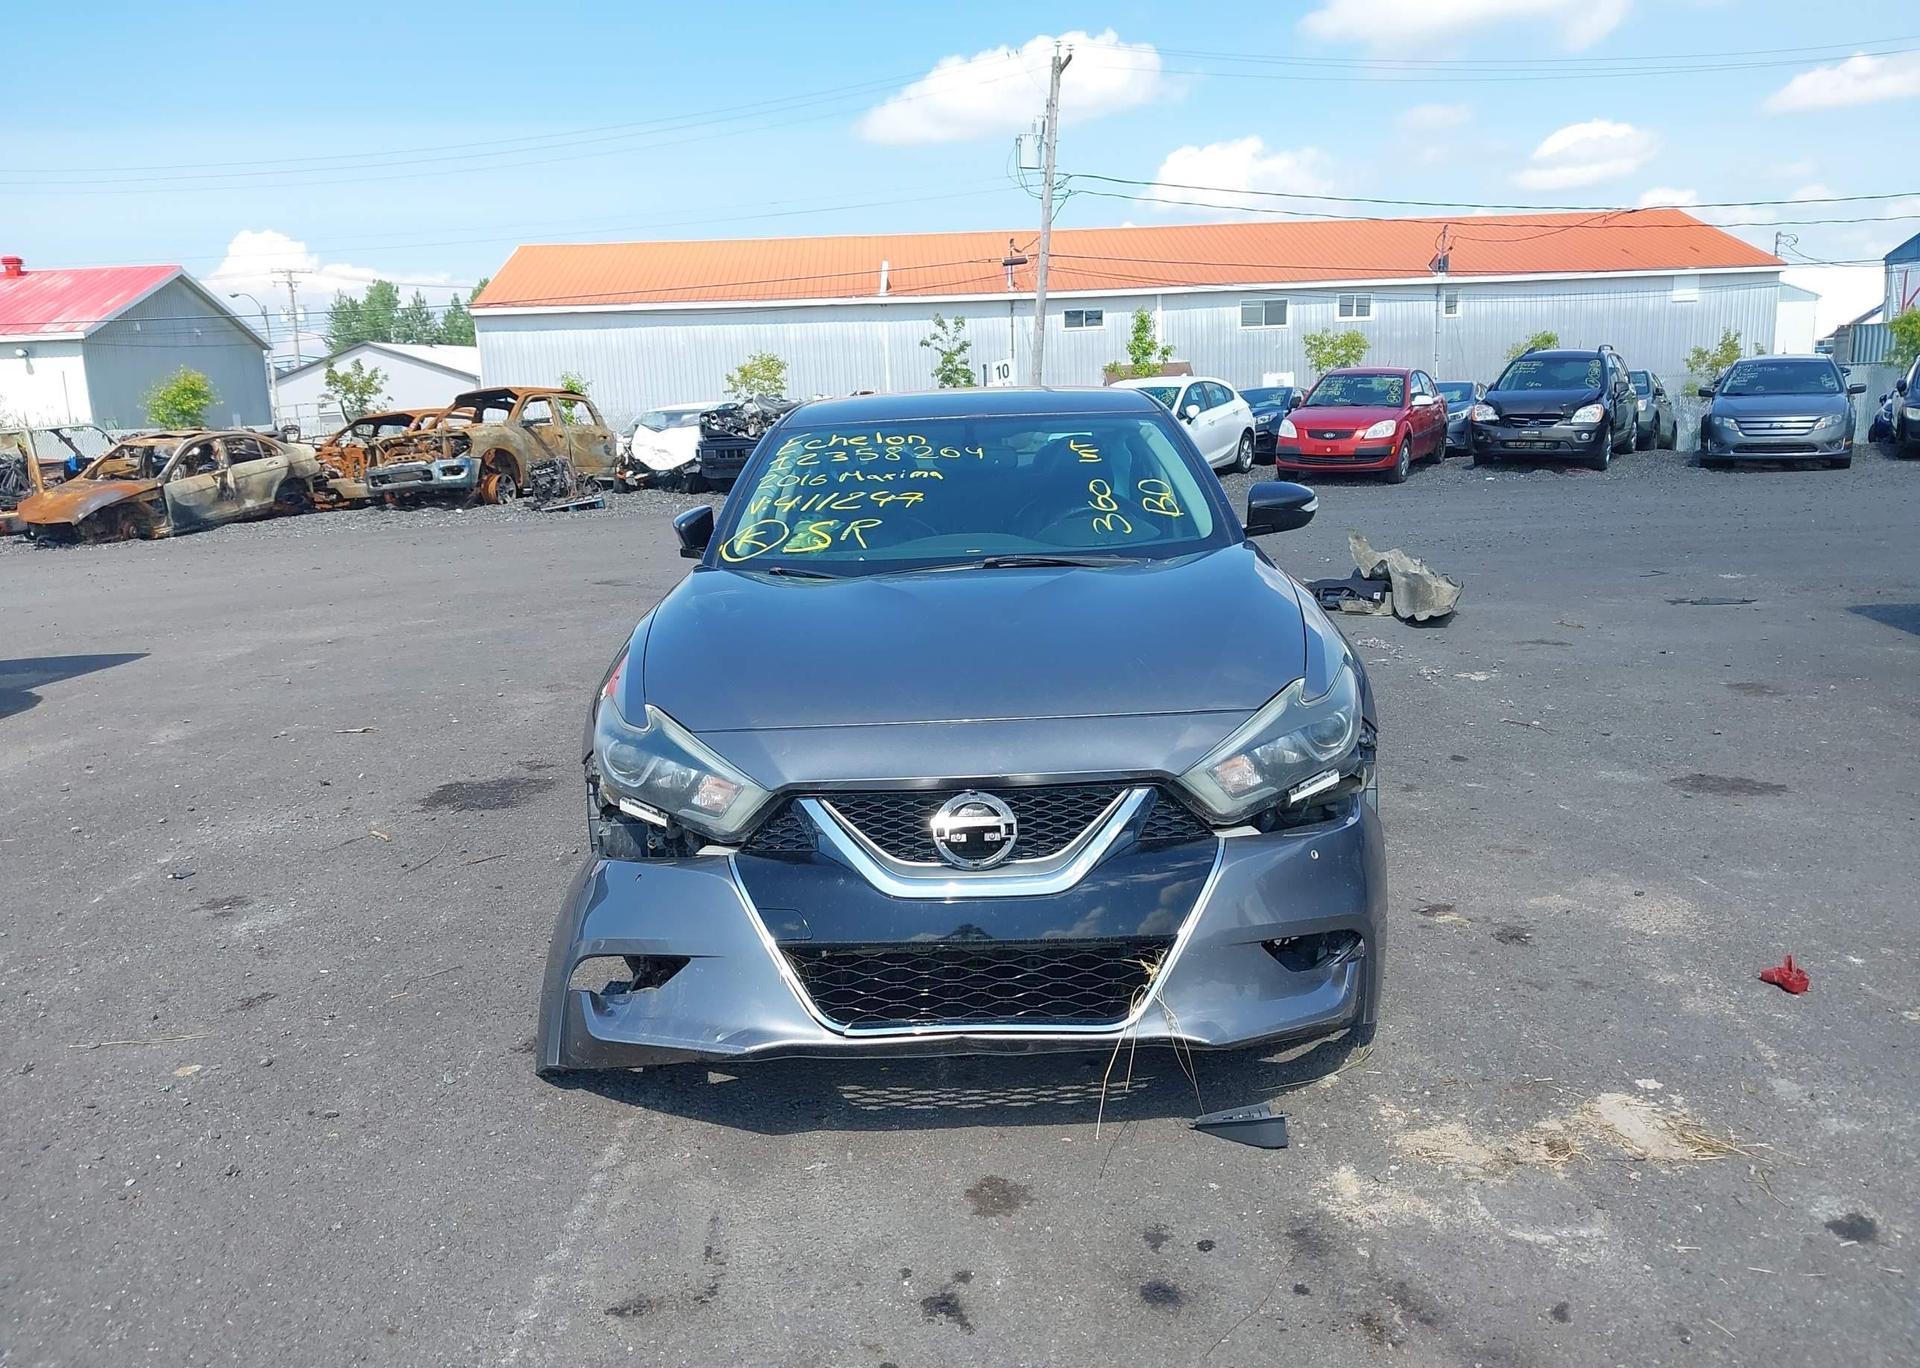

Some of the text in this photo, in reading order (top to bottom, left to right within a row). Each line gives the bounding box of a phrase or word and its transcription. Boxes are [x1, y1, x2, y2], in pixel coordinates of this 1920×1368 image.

[996, 363, 1009, 380] 10
[776, 431, 926, 456] Echelon
[759, 473, 828, 489] 2016
[1088, 479, 1132, 535] 360
